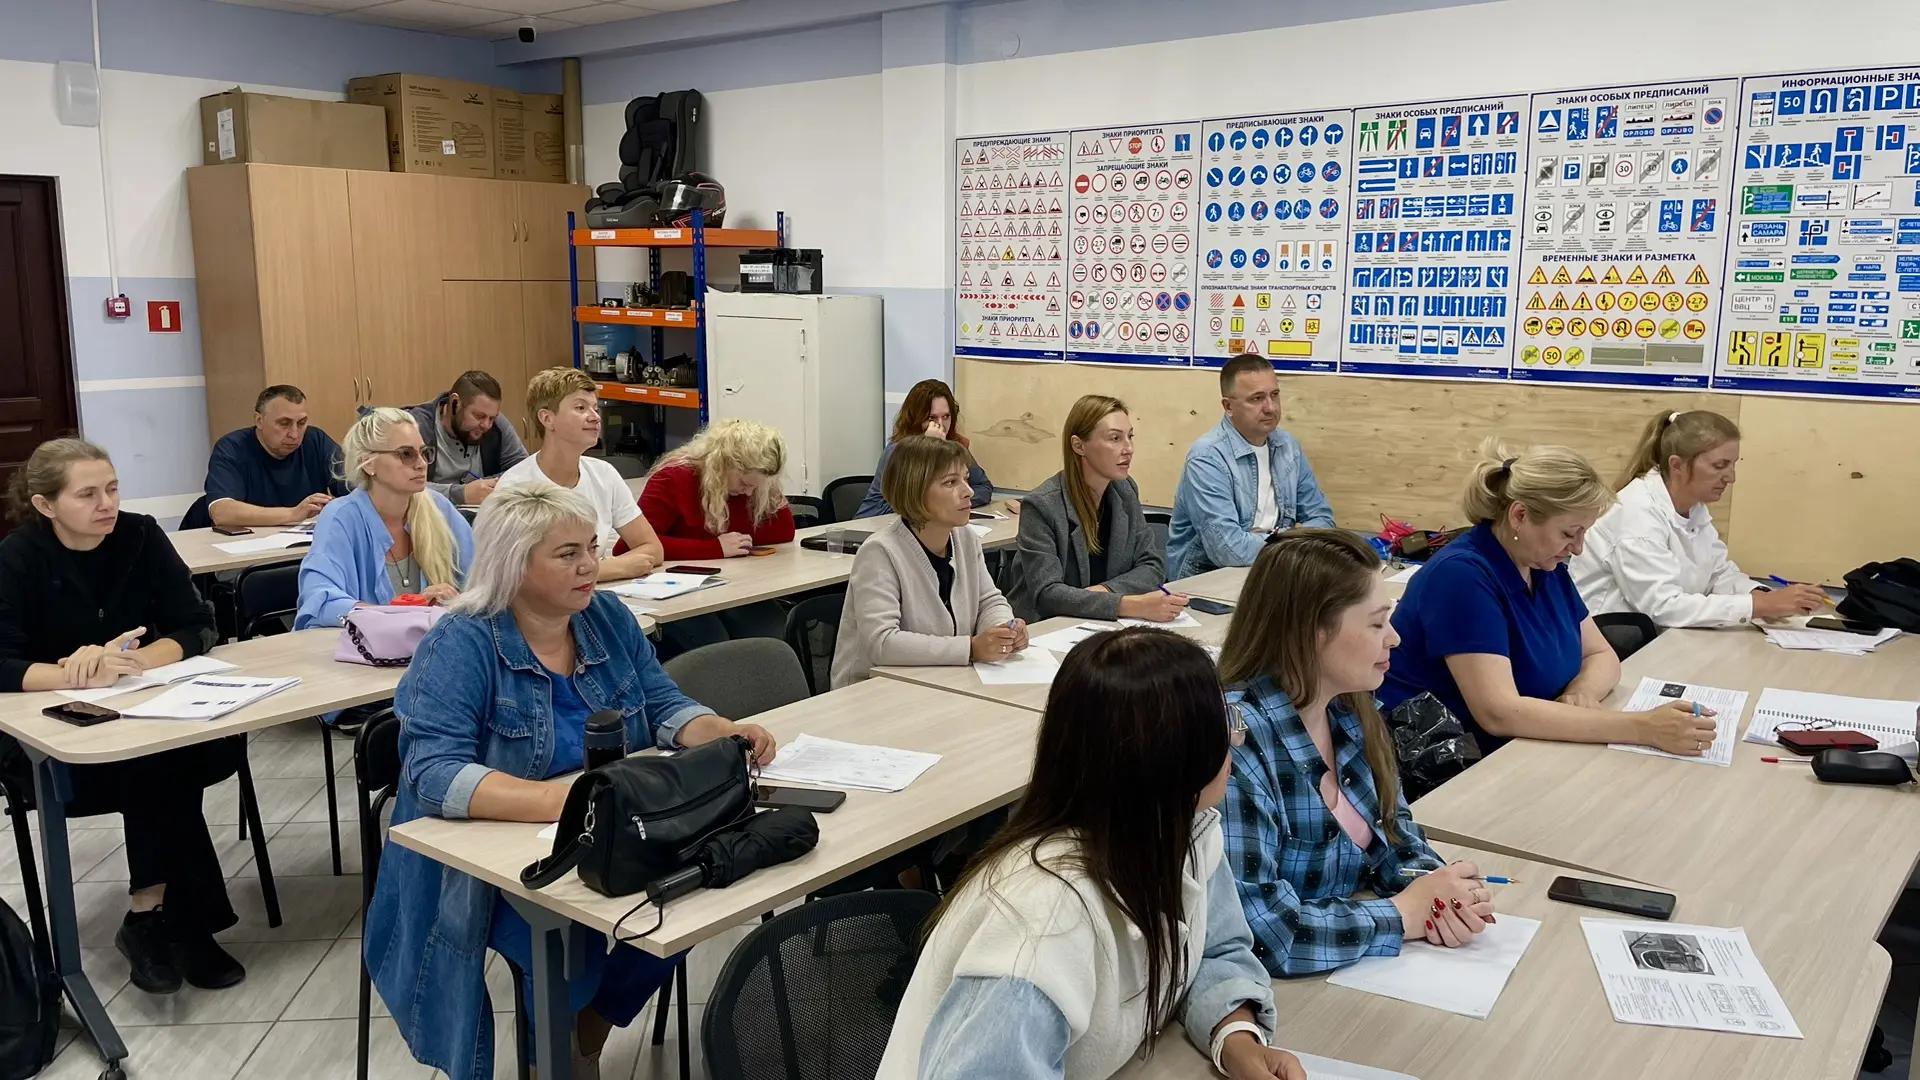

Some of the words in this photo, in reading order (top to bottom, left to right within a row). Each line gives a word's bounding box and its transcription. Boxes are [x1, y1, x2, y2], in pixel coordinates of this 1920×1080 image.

[1782, 74, 1895, 88] ИНФОРМАЦИОННЫЕ
[1556, 96, 1587, 104] ЗНАКИ
[1590, 92, 1630, 102] ОСОБЫХ
[1634, 84, 1709, 98] ПРЕДПИСАНИЙ
[1784, 97, 1800, 108] 50
[1376, 112, 1402, 120] ЗНАКИ
[1404, 109, 1438, 118] ОСОБЫХ
[1440, 102, 1504, 115] ПРЕДПИСАНИЙ
[1226, 118, 1297, 129] ПРЕДПИСЫВАЮЩИЕ
[1300, 116, 1324, 124] ЗНАКИ
[1124, 128, 1163, 137] ПРИОРИТЕТА
[973, 138, 1032, 147] ПРЕДУПРЕЖДАЮЩИЕ
[1096, 164, 1145, 172] ЗАПРЕЩАЮЩИЕ
[1542, 254, 1598, 262] ВРЕМЕННЫЕ
[1600, 254, 1632, 262] ЗНАКИ
[1546, 352, 1558, 360] 50
